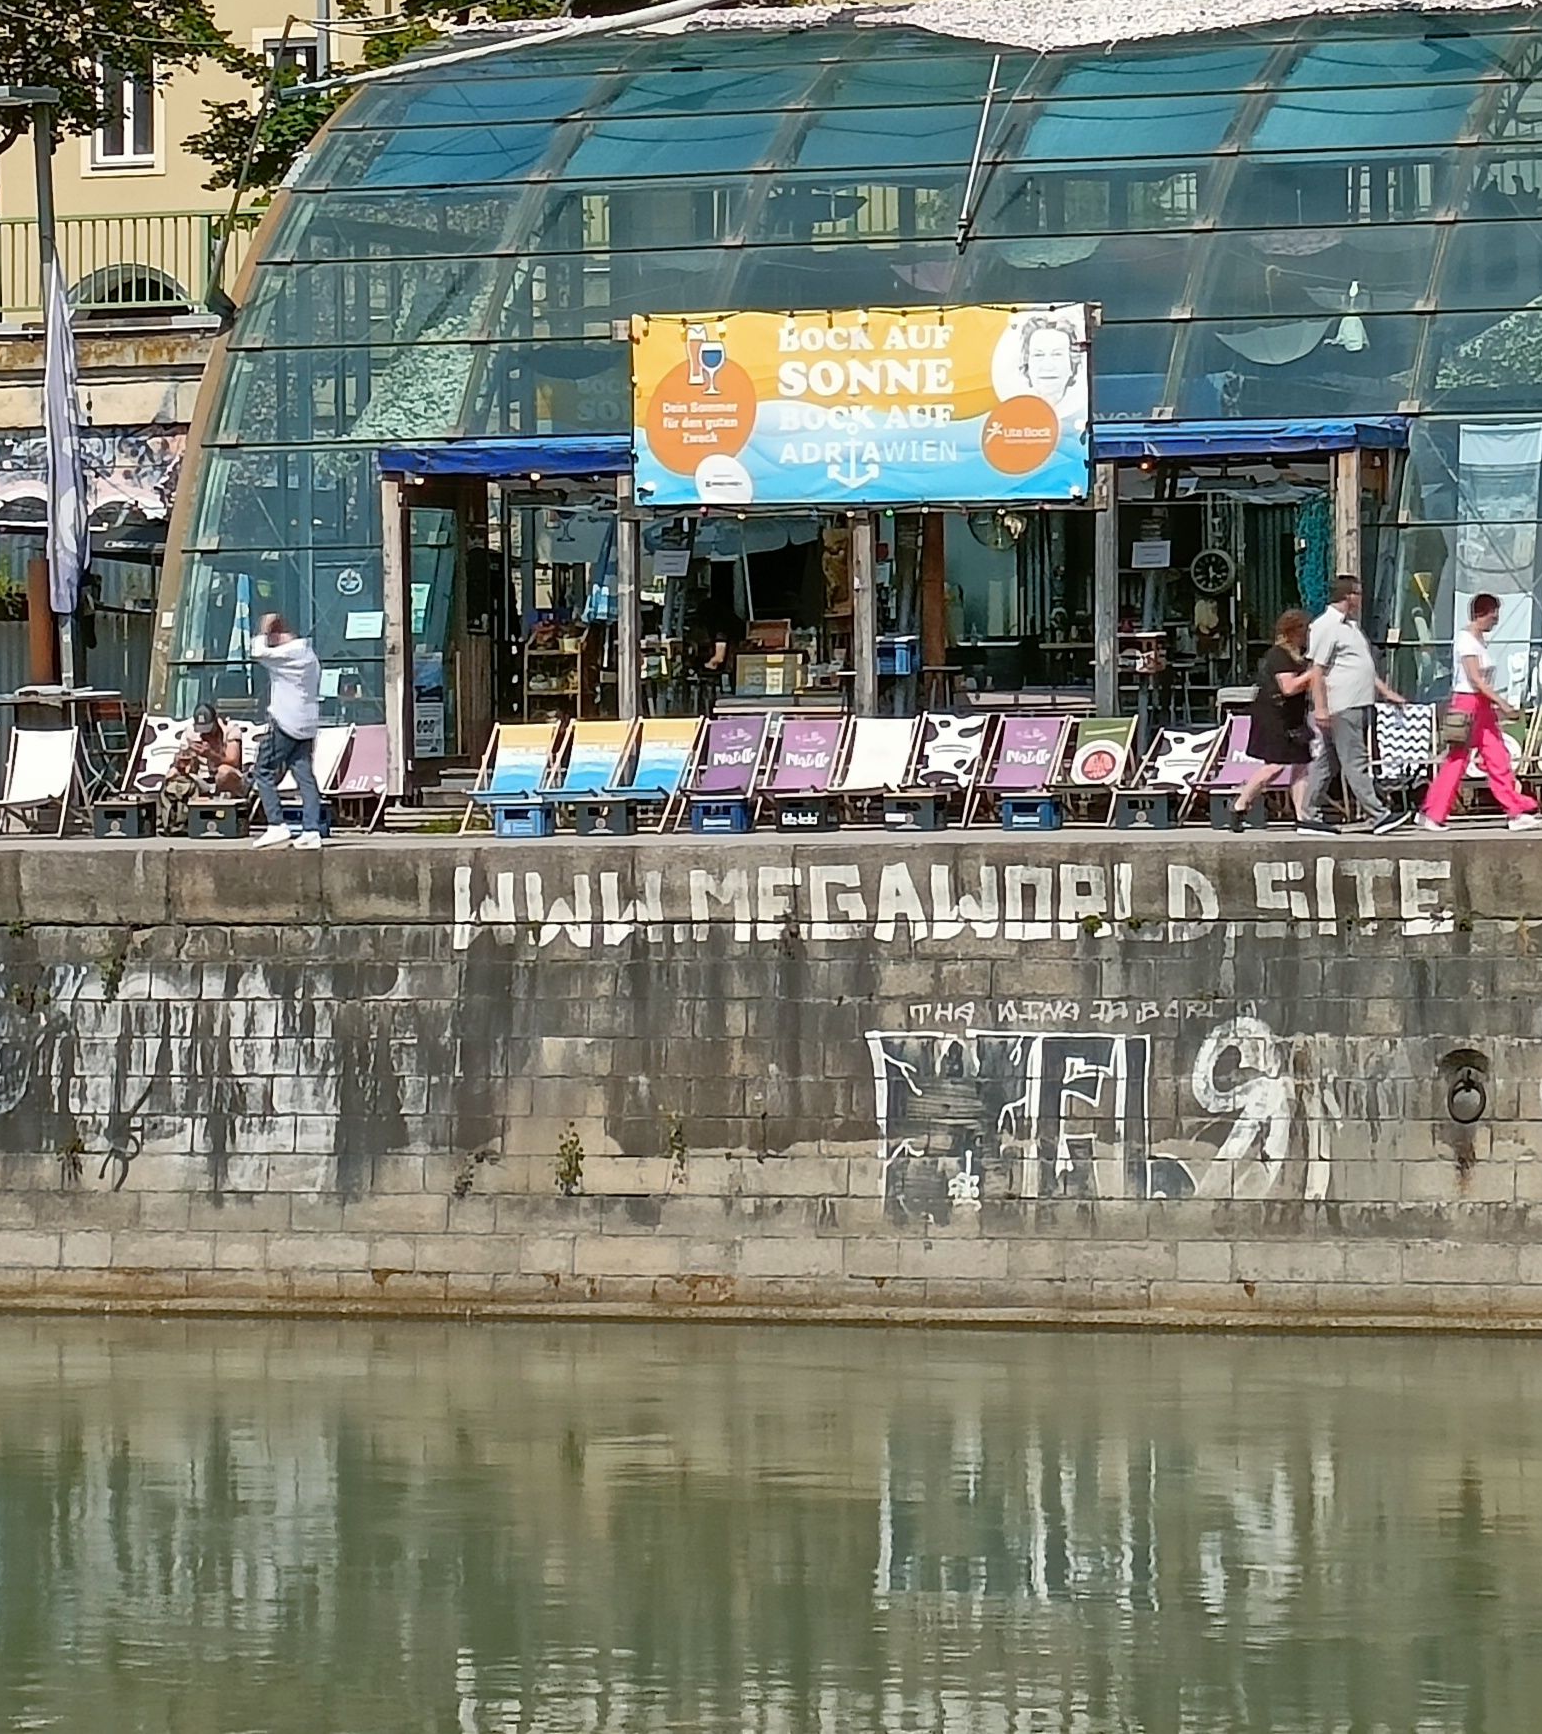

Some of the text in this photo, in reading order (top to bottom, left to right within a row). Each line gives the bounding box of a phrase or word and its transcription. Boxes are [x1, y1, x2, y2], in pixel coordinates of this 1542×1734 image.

[778, 324, 955, 352] BOCK AUF
[777, 357, 955, 397] SONNE
[779, 403, 955, 431] BOCK AUF
